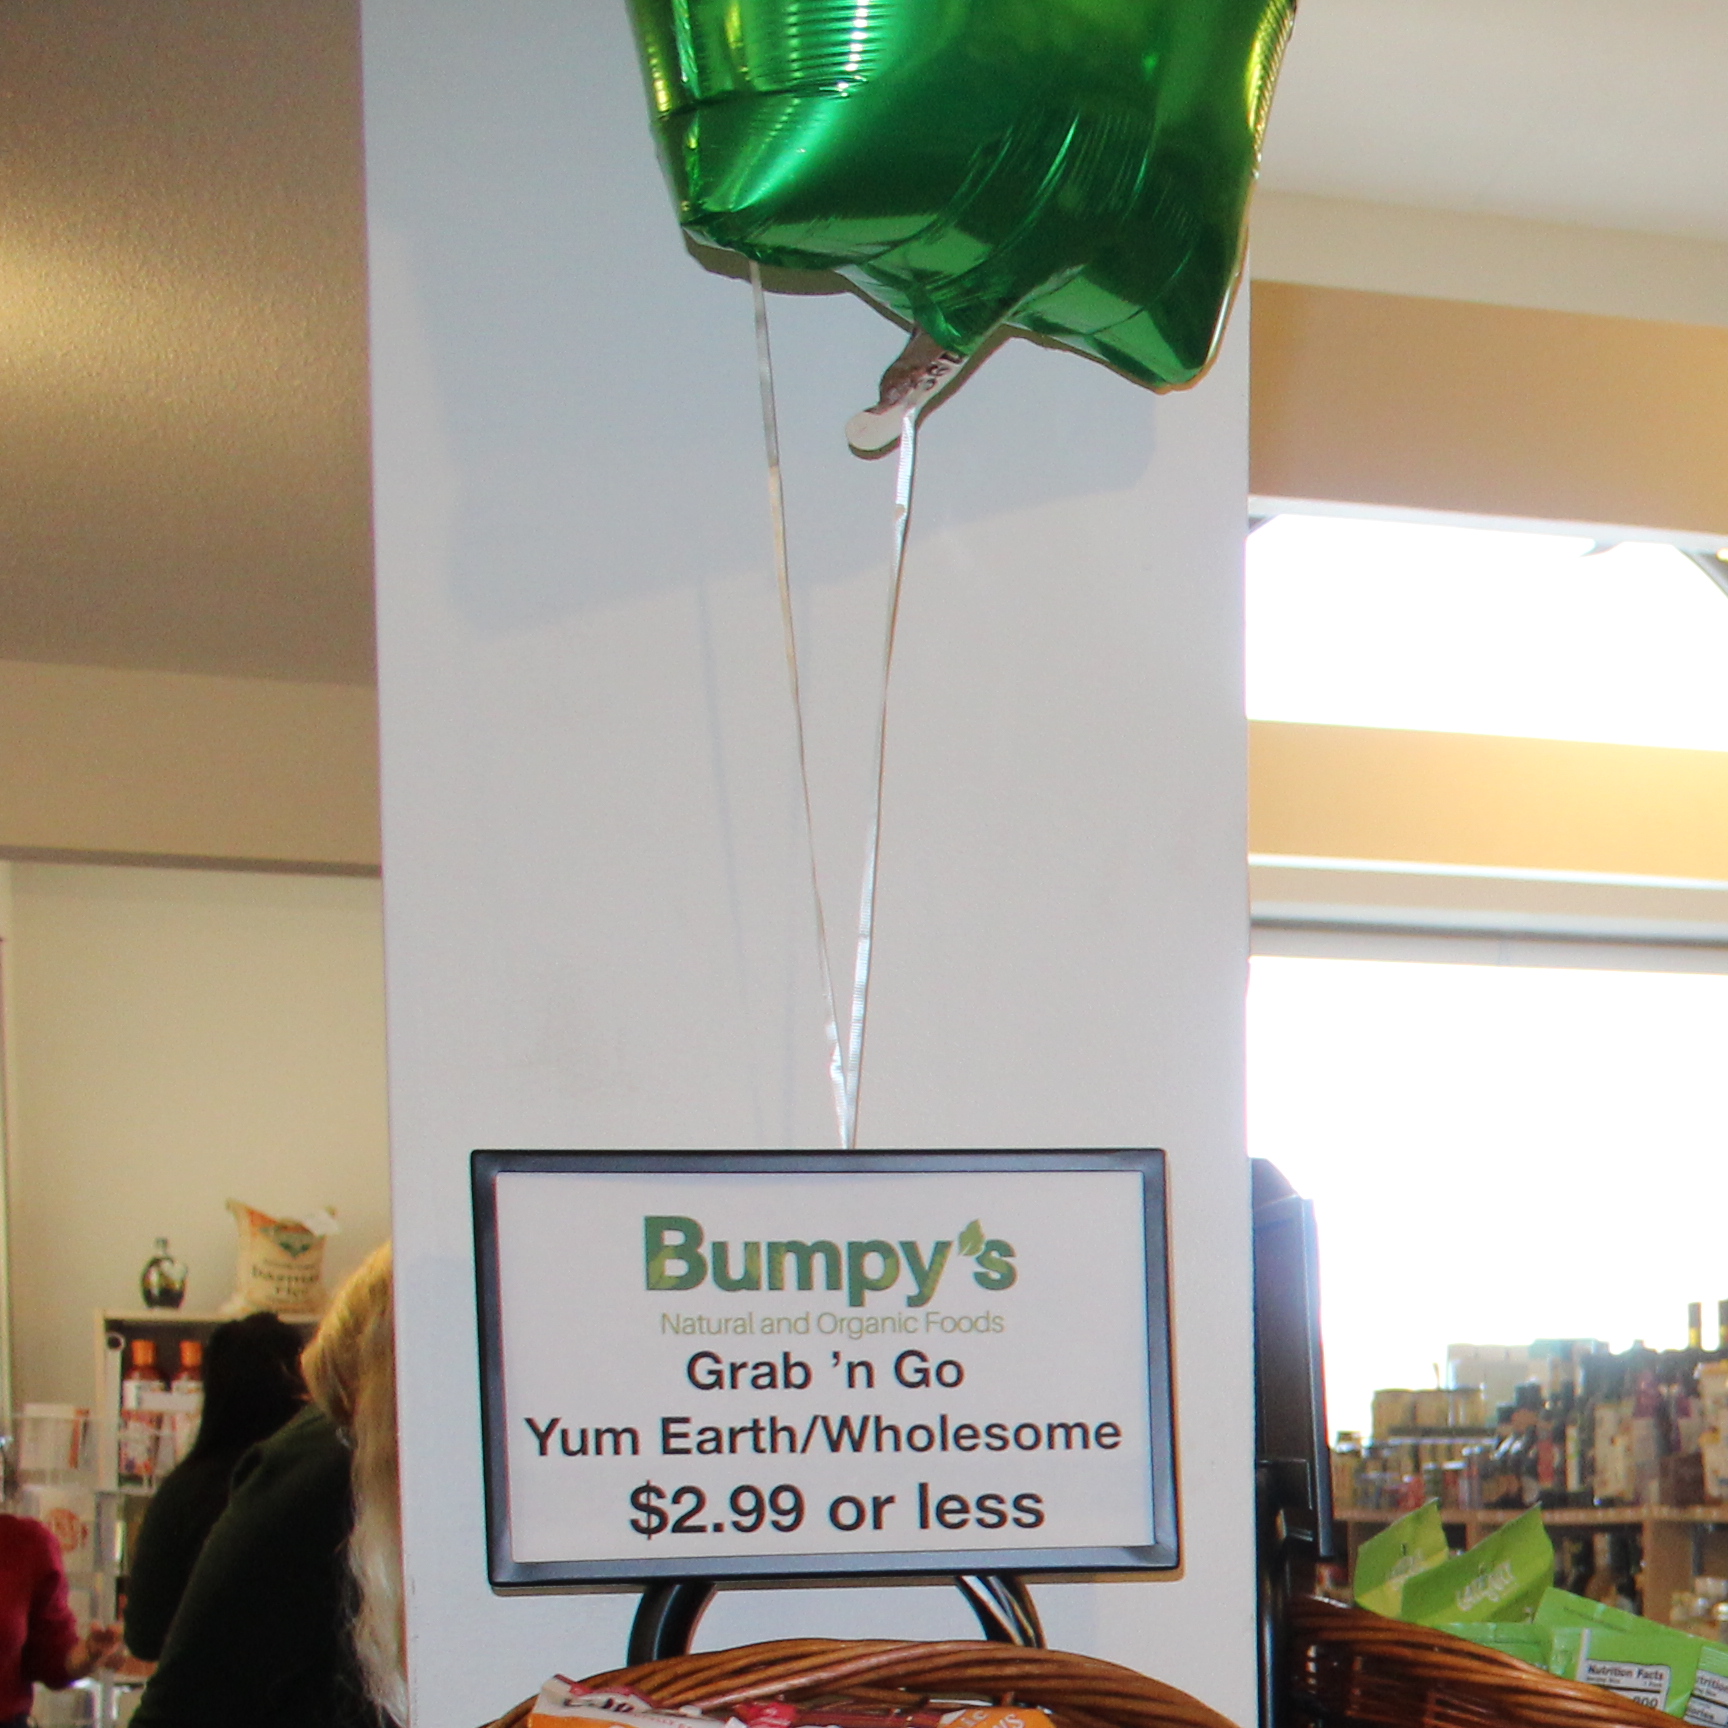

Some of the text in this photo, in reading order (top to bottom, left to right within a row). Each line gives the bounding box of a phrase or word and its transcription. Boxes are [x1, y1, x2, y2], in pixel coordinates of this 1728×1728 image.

[643, 1214, 1018, 1308] Bumpy's
[660, 1309, 1005, 1339] Natural and Organic Foods
[686, 1349, 966, 1391] Grab 'n Go
[525, 1412, 1123, 1457] Yum Earth/Wholesome
[629, 1480, 1046, 1539] $2.99 or less
[1587, 1665, 1664, 1681] Nutrition Facts
